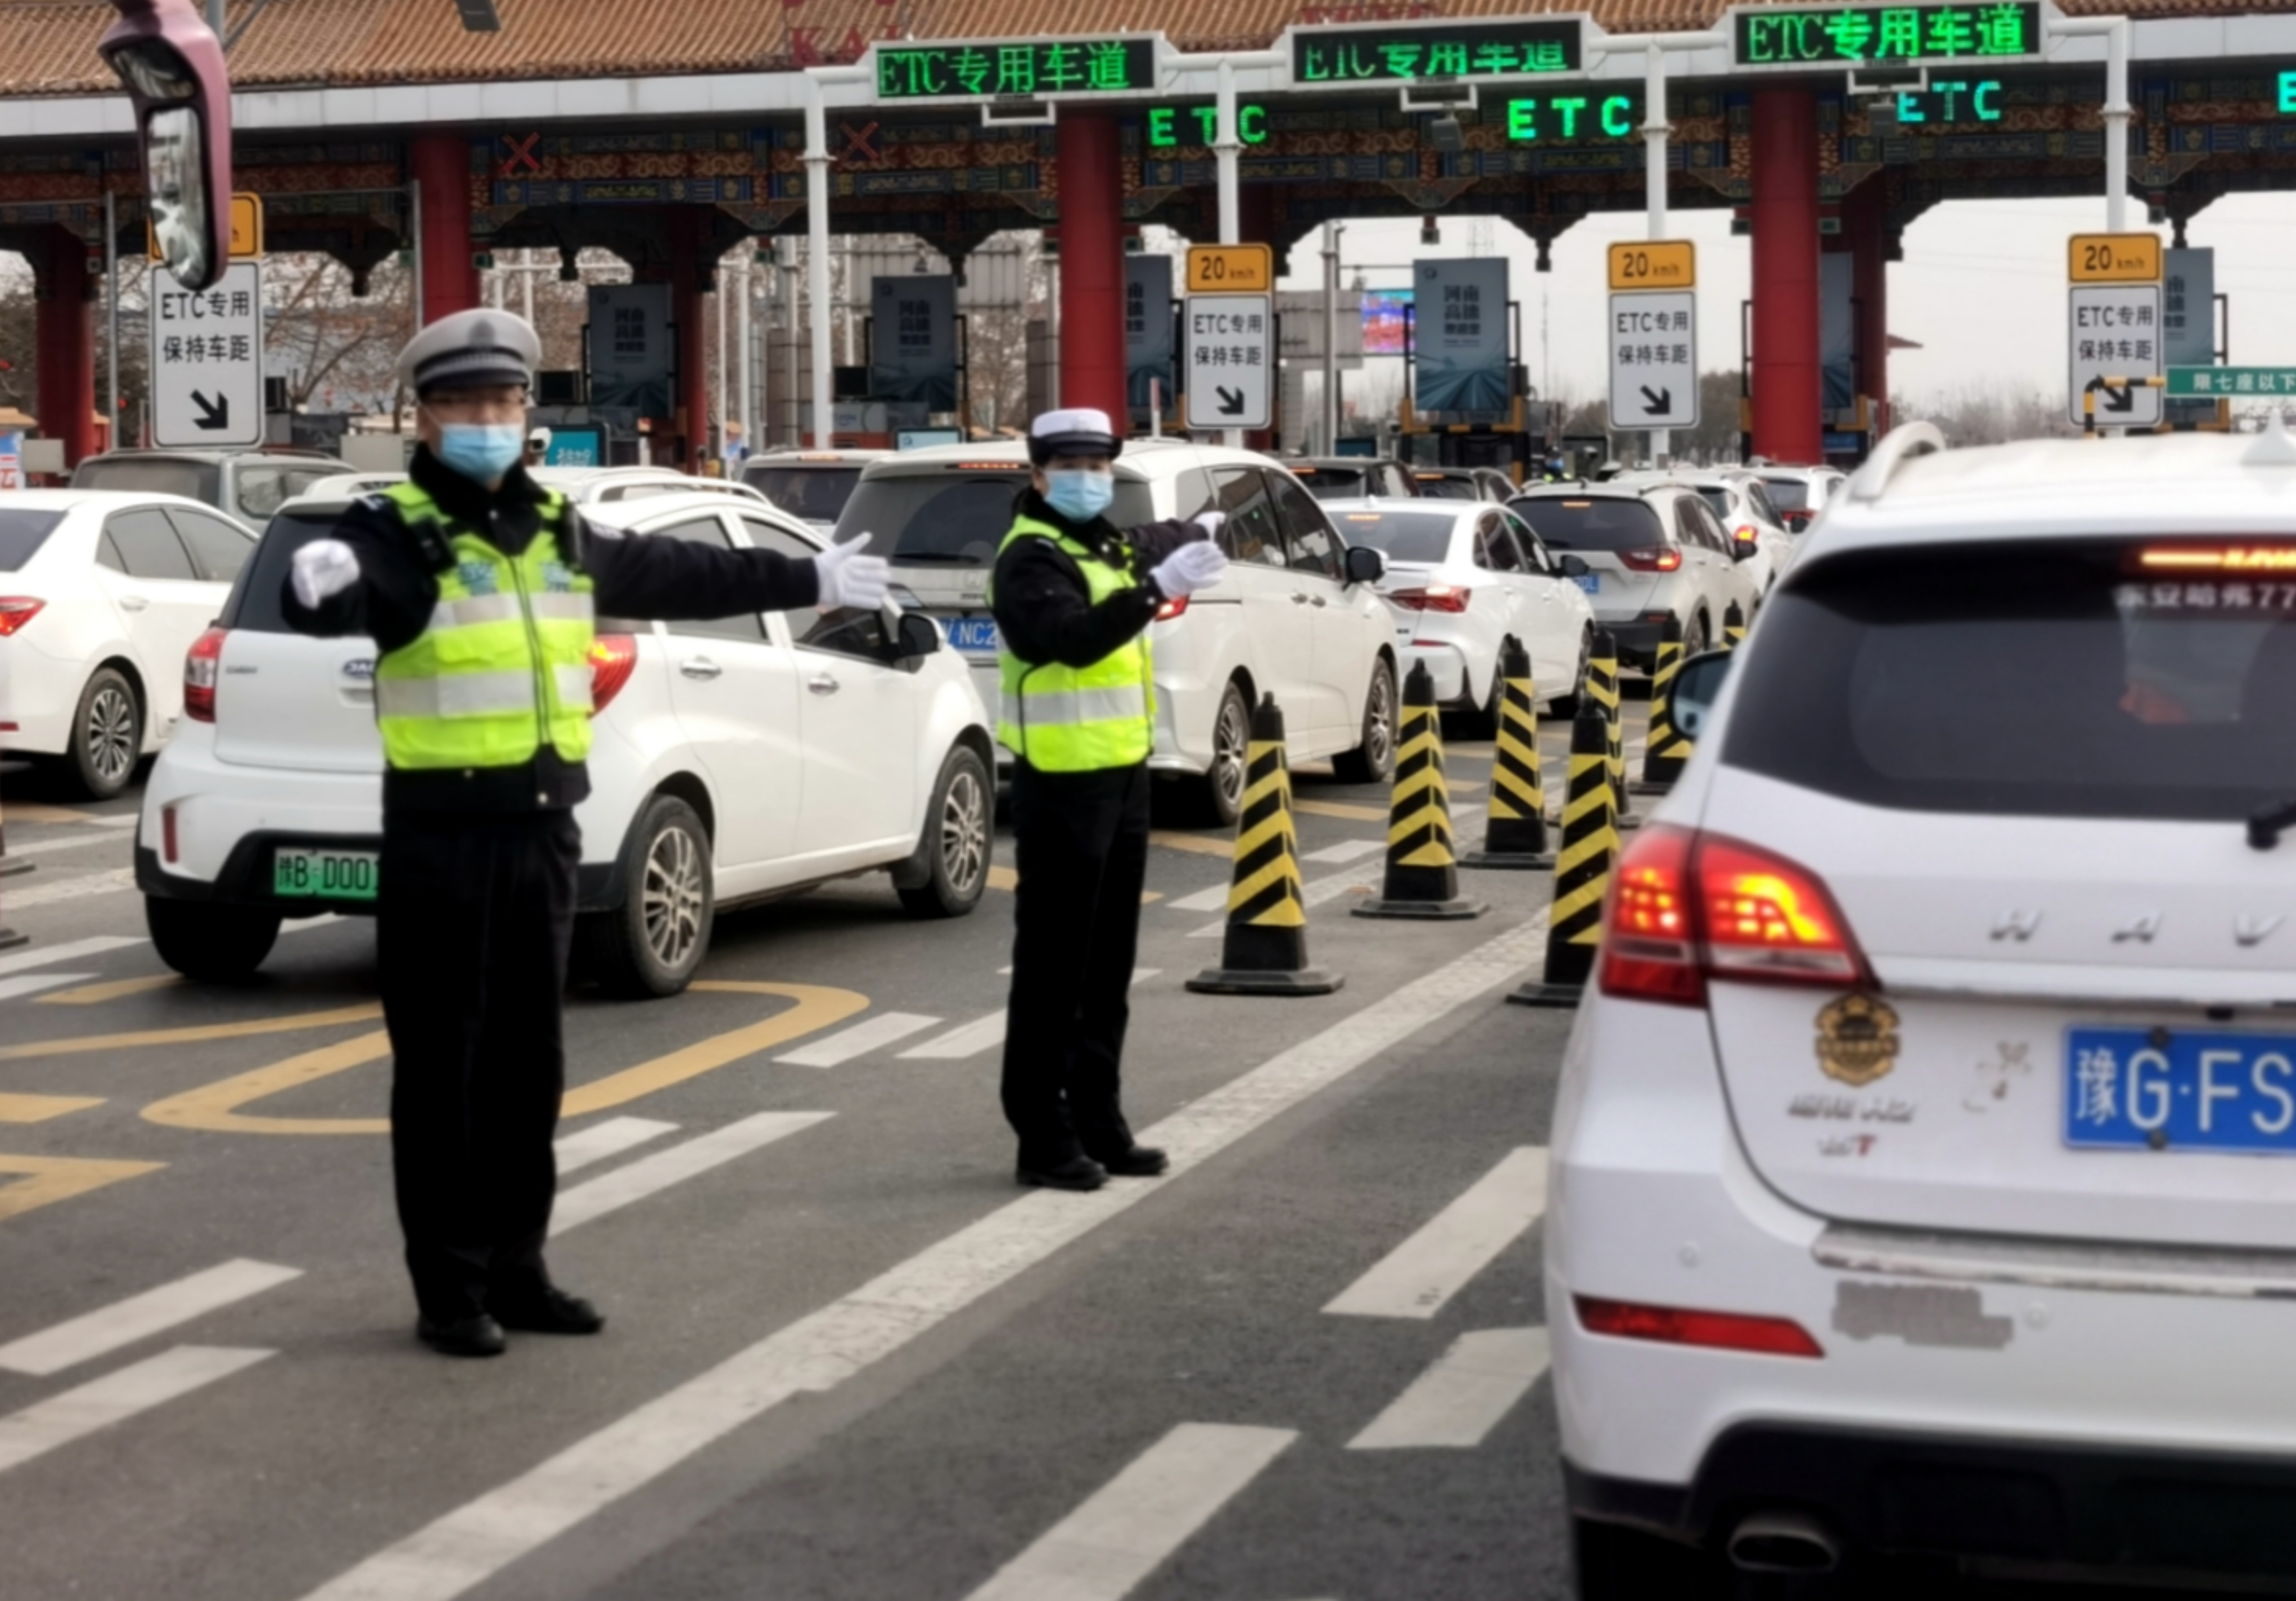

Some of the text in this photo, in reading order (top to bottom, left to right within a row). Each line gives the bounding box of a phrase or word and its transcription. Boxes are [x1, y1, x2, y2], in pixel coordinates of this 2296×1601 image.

[1748, 3, 2025, 60] ETC专用车道
[877, 42, 1130, 95] ETC专用车道
[1898, 81, 2000, 121] ETC
[1149, 106, 1266, 145] ETC
[1508, 97, 1630, 138] ETC
[1201, 257, 1256, 281] 20 km/h
[1622, 254, 1680, 278] 20 km/h
[2084, 246, 2145, 271] 20 km/h
[162, 291, 250, 319] ETC专用
[2077, 306, 2154, 328] ETC专用
[1194, 314, 1263, 336] ETC专用
[1617, 311, 1688, 332] ETC专用
[163, 334, 250, 363] 保持车距
[1195, 346, 1263, 367] 保持车距
[1618, 344, 1688, 365] 保持车距
[2078, 339, 2154, 362] 保持车距
